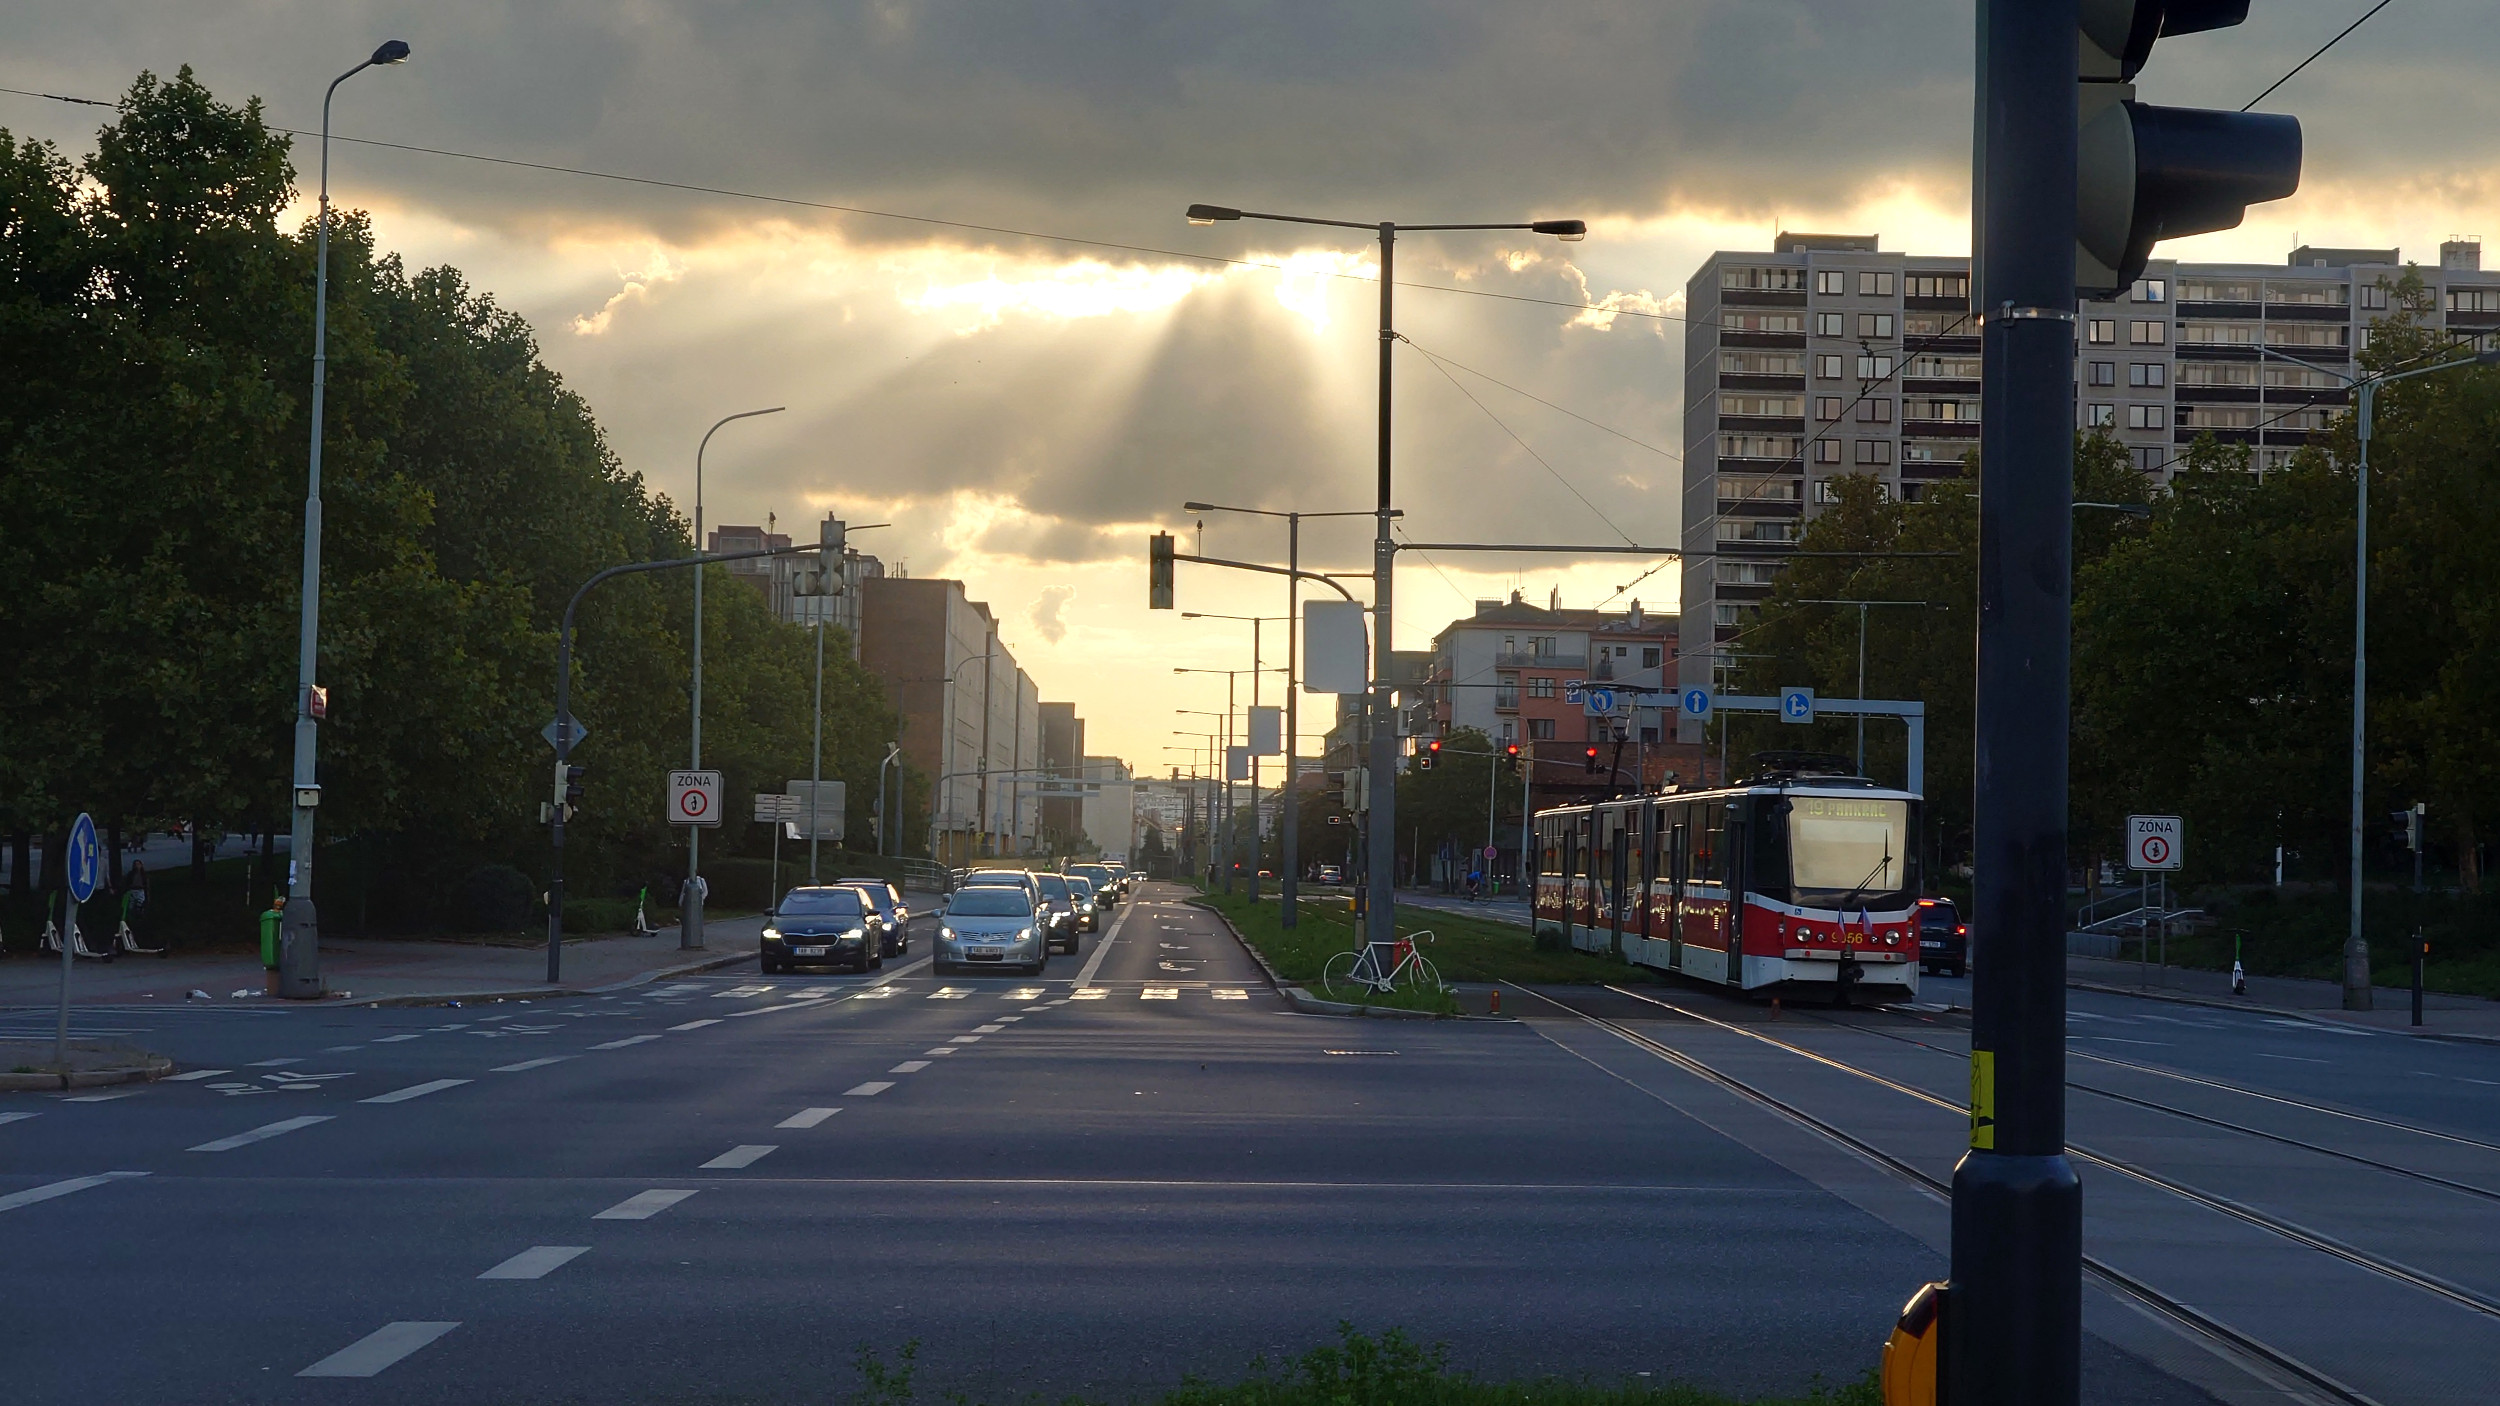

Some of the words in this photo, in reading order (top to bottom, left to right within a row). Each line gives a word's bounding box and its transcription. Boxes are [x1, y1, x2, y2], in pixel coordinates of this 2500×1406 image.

[677, 773, 711, 787] ZÓNA
[1807, 799, 1824, 816] 19
[2138, 818, 2173, 833] ZÓNA
[1831, 932, 1864, 944] 956
